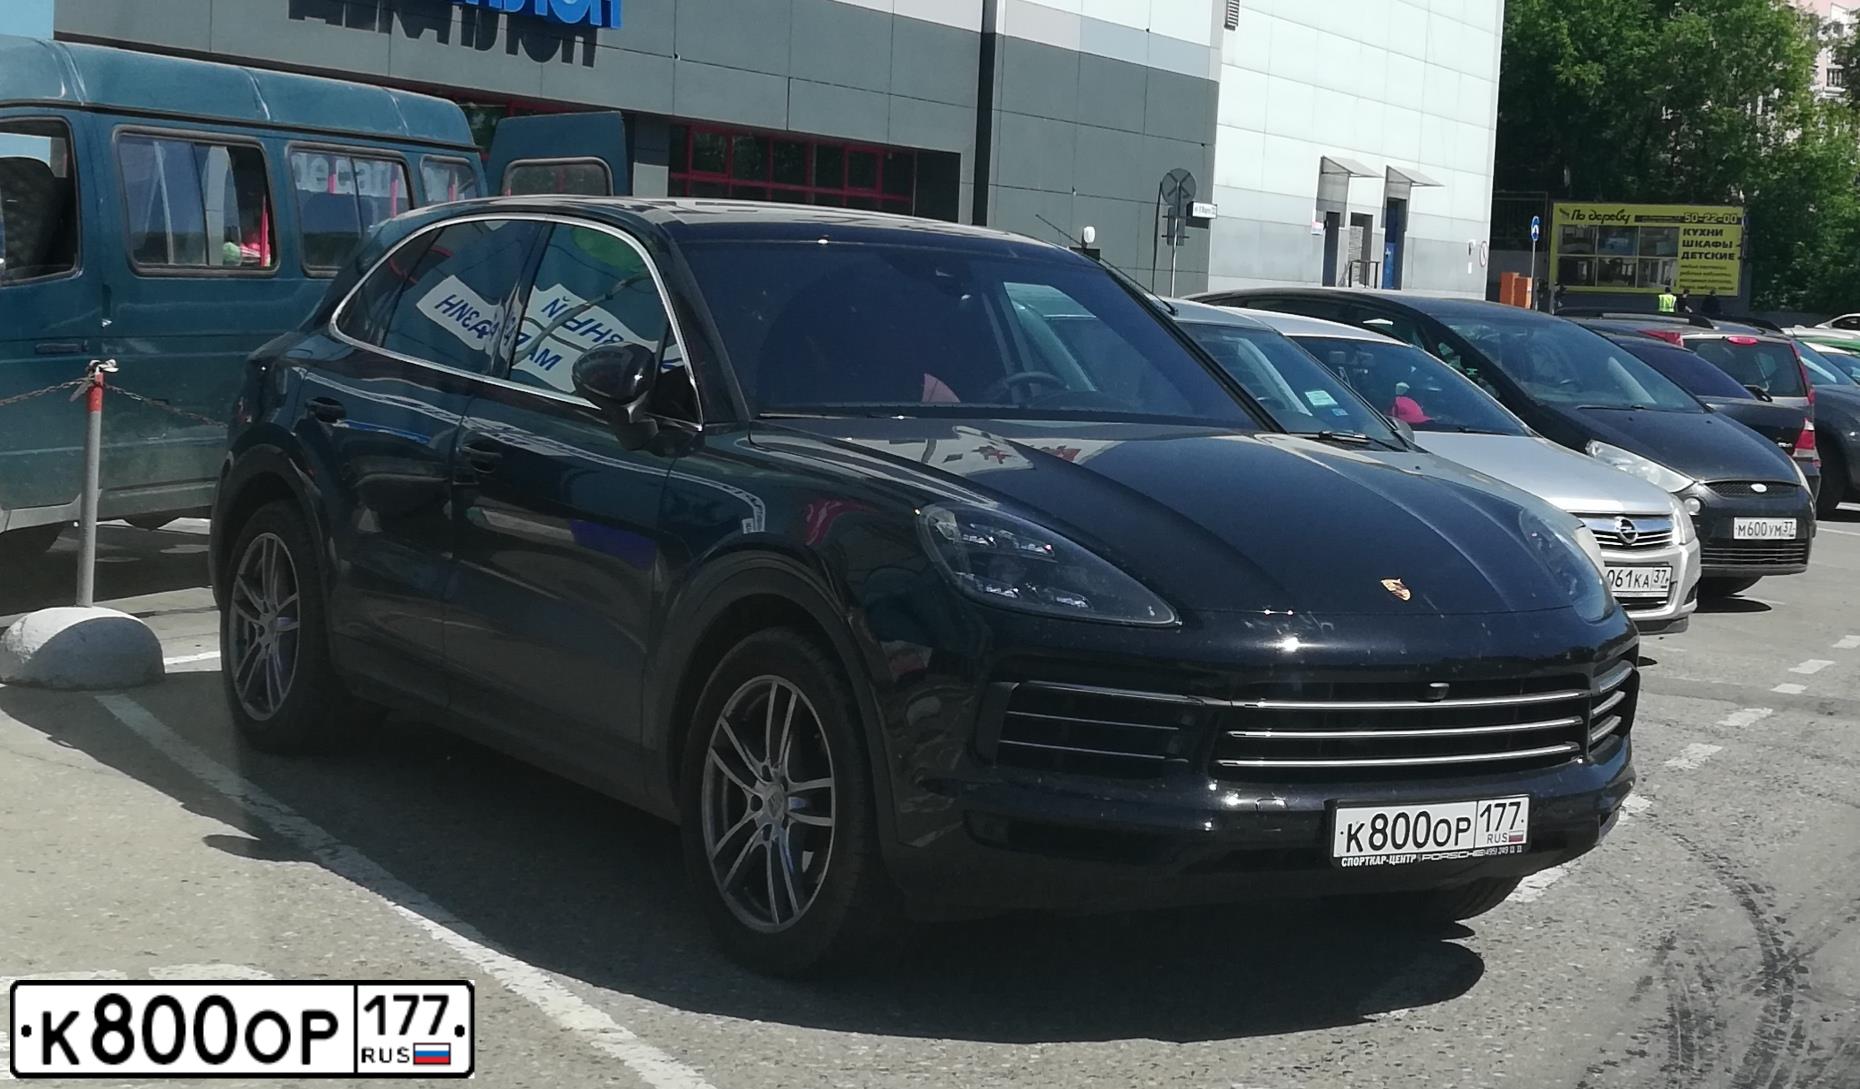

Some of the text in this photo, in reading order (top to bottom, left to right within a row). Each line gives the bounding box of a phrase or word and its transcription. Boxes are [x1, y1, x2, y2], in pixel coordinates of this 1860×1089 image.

[1682, 228, 1723, 237] КУХНИ
[1682, 239, 1732, 249] ШКАФЫ
[1681, 251, 1735, 261] ДЕТСКИЕ
[1607, 569, 1667, 588] 061КА 37
[1346, 801, 1522, 853] К800ОР 177
[1487, 833, 1508, 844] RUS
[1341, 854, 1416, 867] СПОРТКАР-ЦЕНТР
[1422, 850, 1485, 861] PORSCHE
